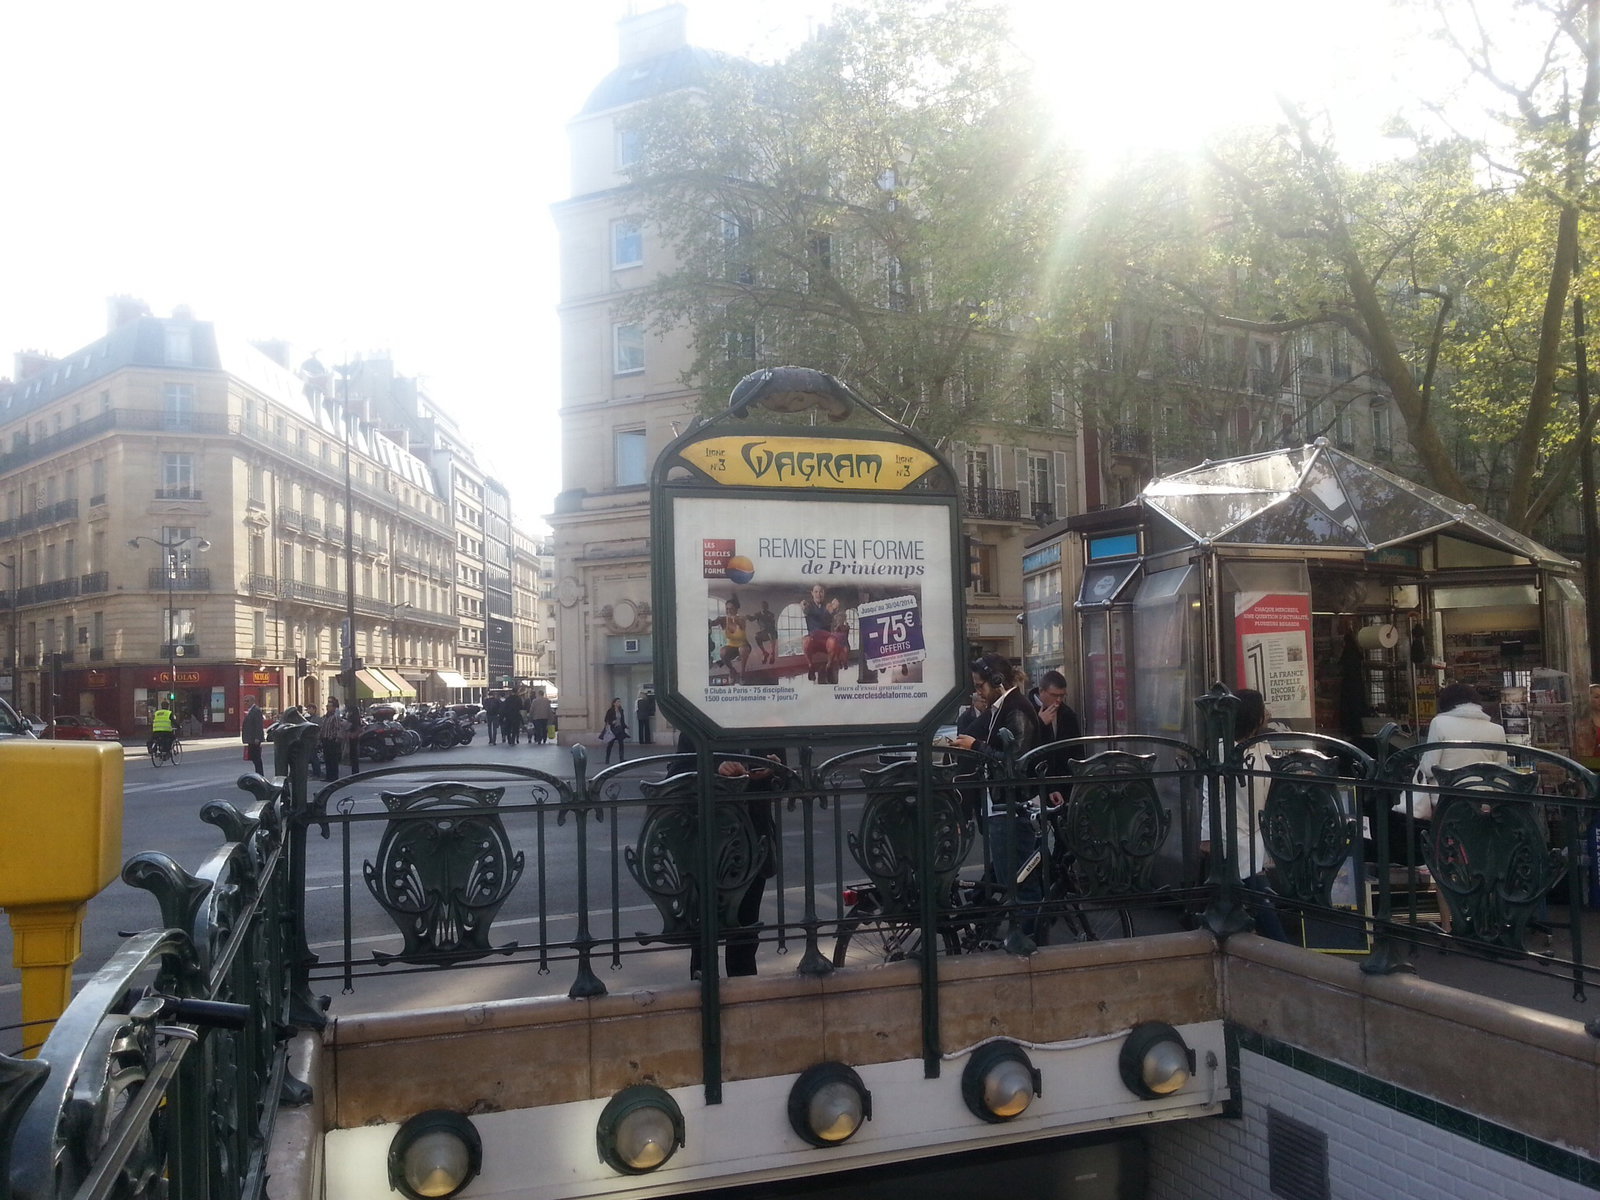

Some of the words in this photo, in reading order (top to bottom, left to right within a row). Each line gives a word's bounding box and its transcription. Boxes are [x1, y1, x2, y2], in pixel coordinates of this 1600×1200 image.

[741, 441, 883, 484] WAGRAM
[759, 537, 827, 559] REMISE
[833, 539, 856, 560] EN
[863, 540, 925, 561] FORME
[704, 567, 726, 575] FORME
[801, 560, 823, 575] de
[828, 560, 925, 579] Printemps
[879, 641, 911, 654] OFFERTS
[1279, 670, 1303, 678] FRANCE
[709, 687, 727, 695] Clubs
[733, 686, 749, 694] Paris
[753, 686, 761, 694] 75
[762, 686, 795, 695] disciplines
[834, 691, 928, 700] www.cerclesdelaforme.com
